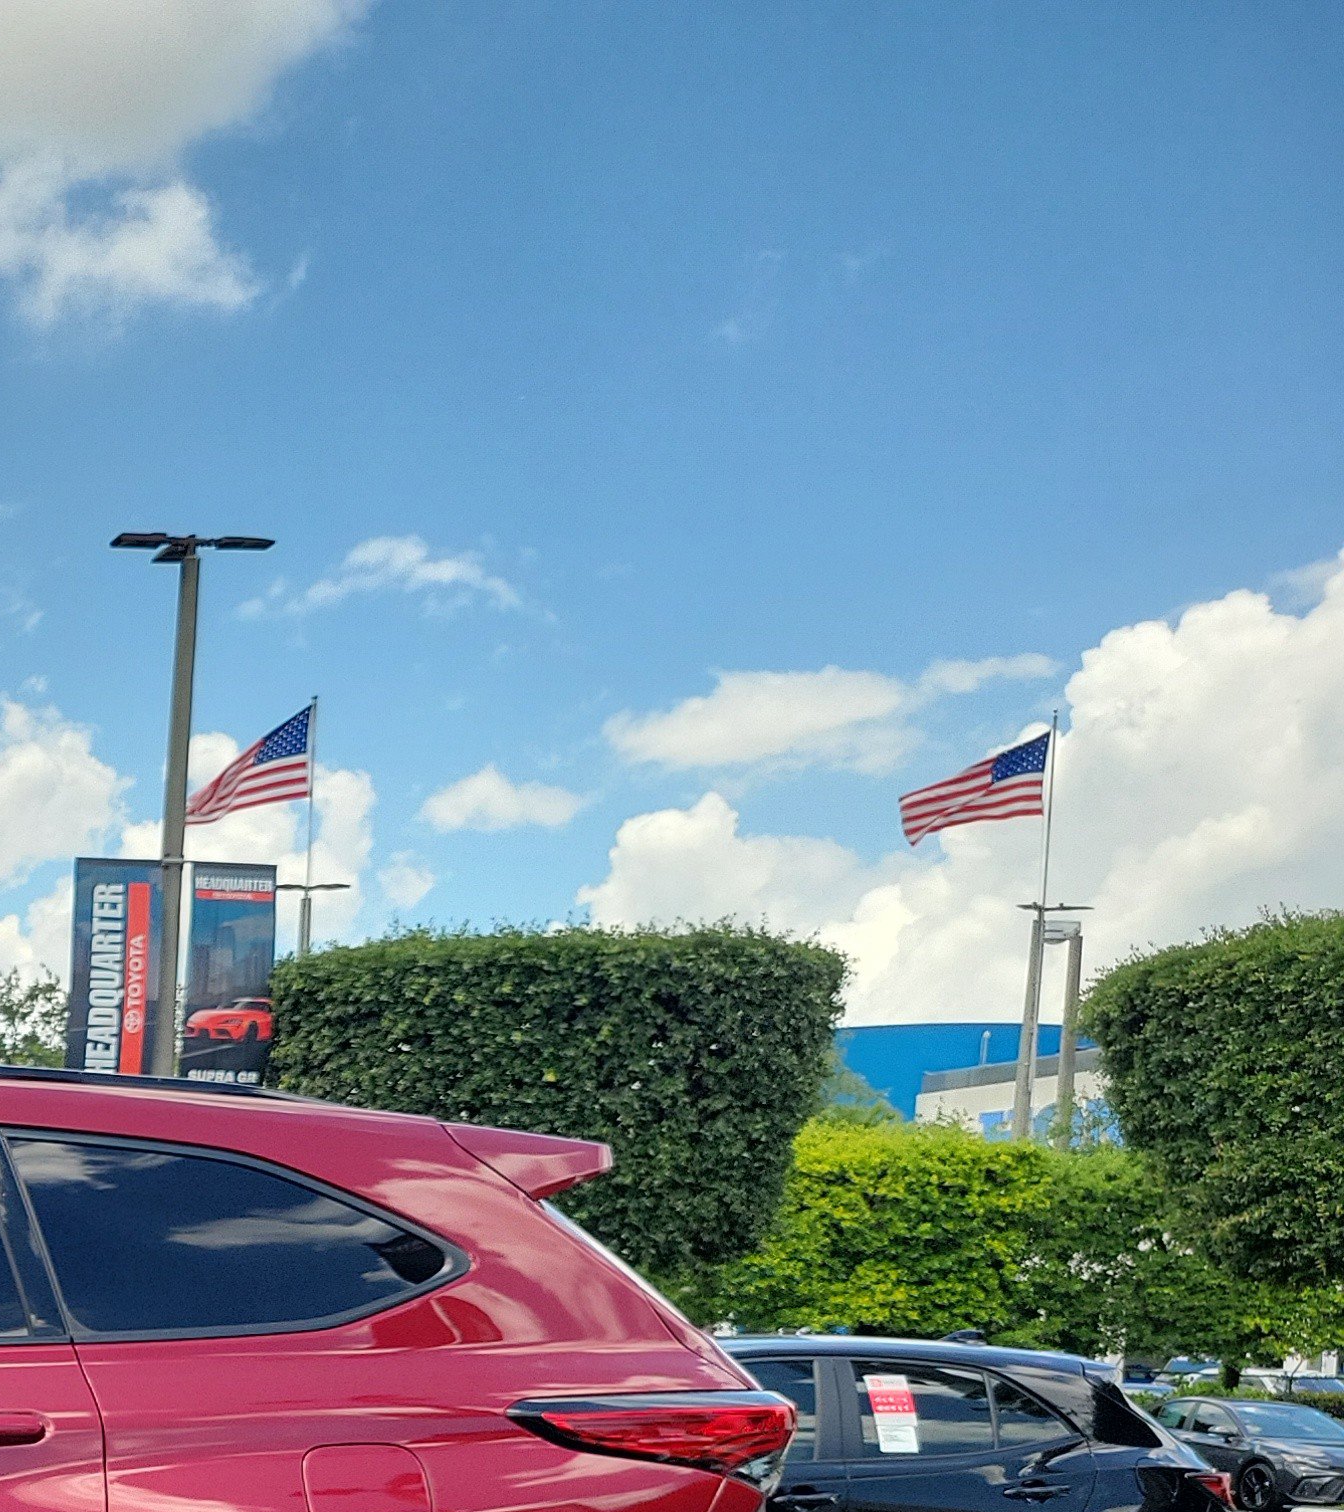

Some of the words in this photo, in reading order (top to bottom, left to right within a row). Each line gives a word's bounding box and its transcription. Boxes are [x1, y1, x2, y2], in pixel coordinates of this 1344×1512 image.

[195, 876, 273, 893] HEADQUARTER
[85, 883, 126, 1073] HEADQUARTER
[127, 934, 146, 1008] TOYOTA
[188, 1069, 235, 1082] SUPRA
